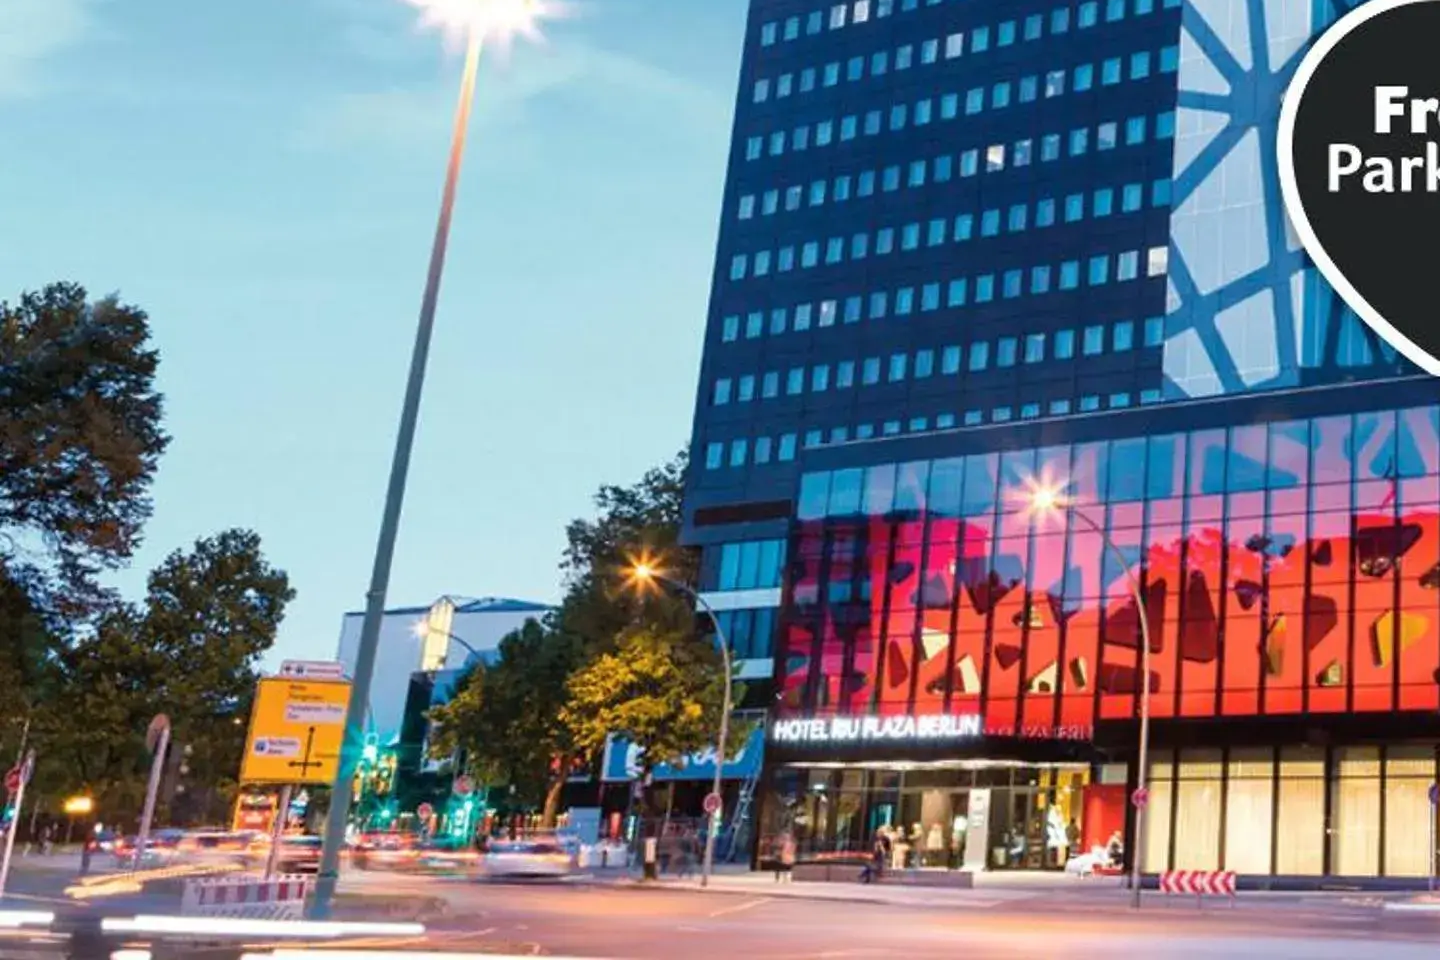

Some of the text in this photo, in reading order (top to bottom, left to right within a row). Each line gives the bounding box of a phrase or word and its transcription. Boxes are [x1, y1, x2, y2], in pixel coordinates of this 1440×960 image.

[774, 718, 829, 740] HOTEL
[862, 715, 916, 739] PLAZA
[917, 713, 980, 738] BERLIN
